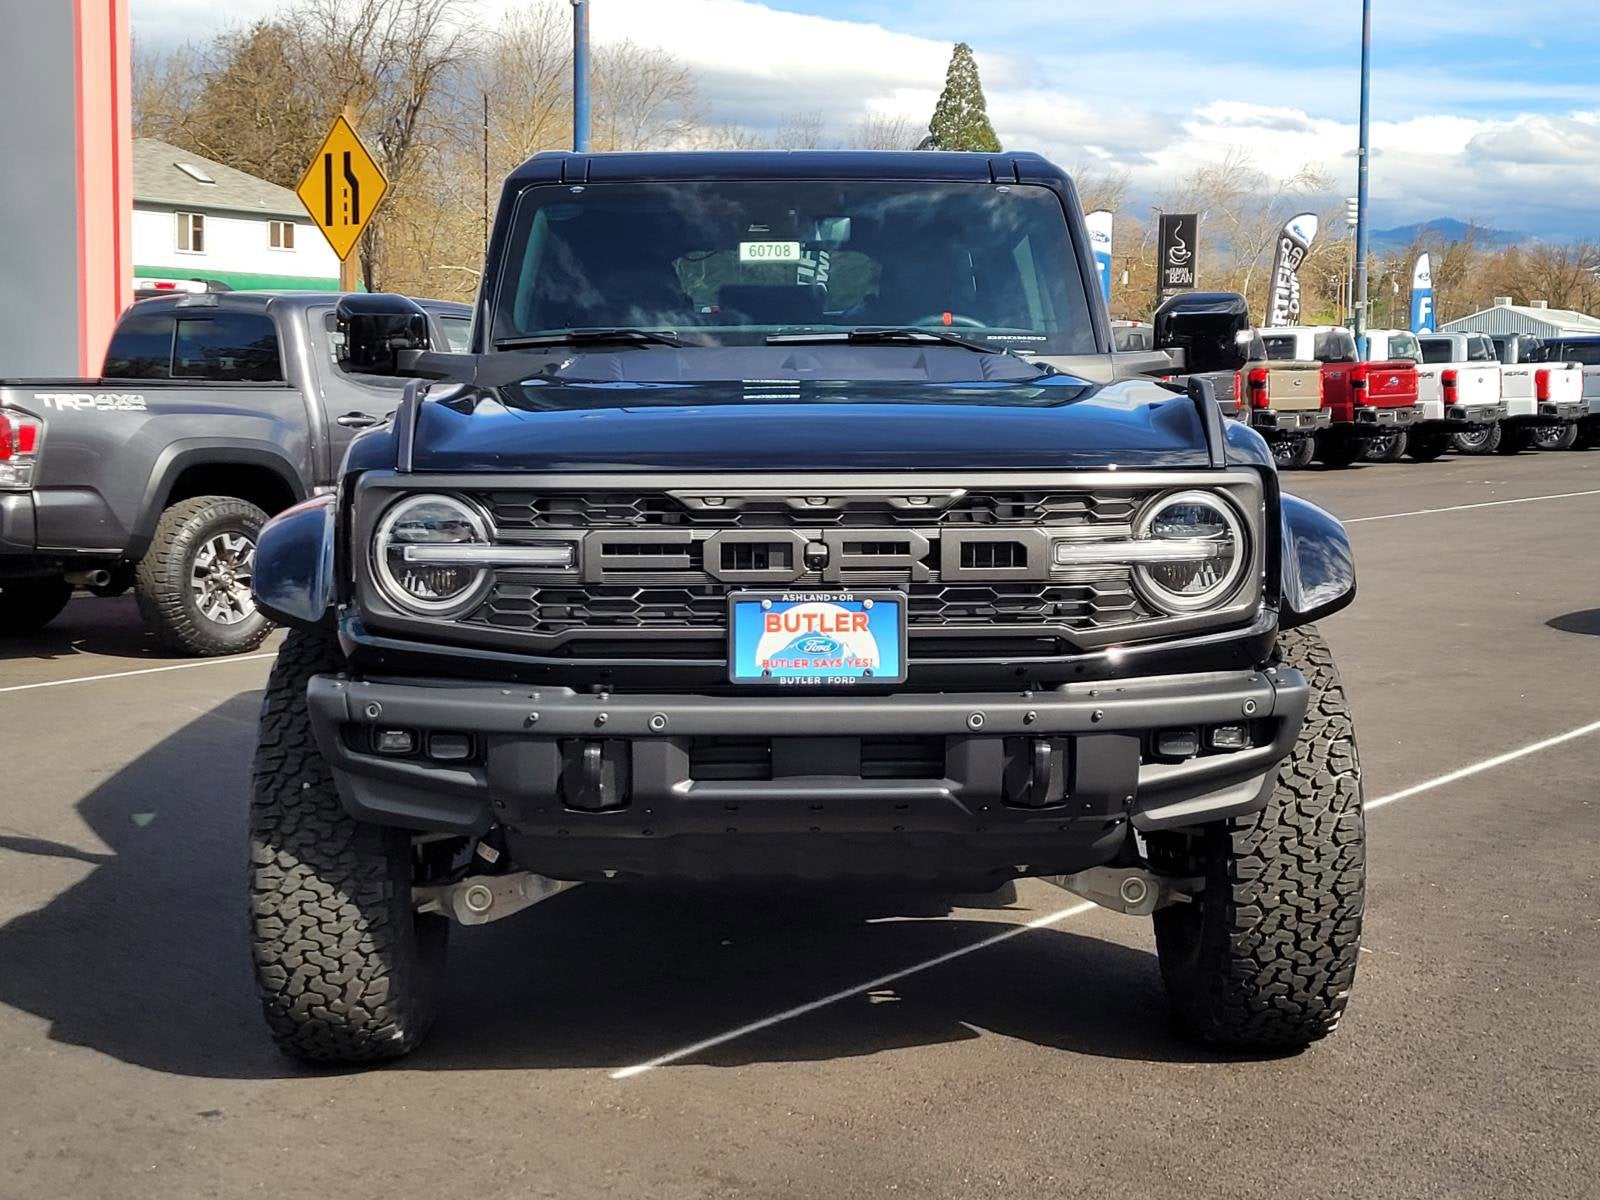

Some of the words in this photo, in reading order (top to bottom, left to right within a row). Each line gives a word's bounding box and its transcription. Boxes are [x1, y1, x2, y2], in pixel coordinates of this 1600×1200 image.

[748, 244, 791, 257] 60708
[1169, 273, 1193, 284] BEAN
[1271, 237, 1293, 328] RTIFIED
[34, 393, 95, 411] TRD
[583, 527, 1052, 584] FORD
[782, 594, 832, 602] ASHLAND
[839, 594, 854, 602] OR
[765, 612, 869, 633] BUTLER
[803, 638, 833, 653] Ford
[762, 658, 809, 669] BUTLER
[813, 658, 843, 668] SAYS
[843, 658, 874, 668] YES!
[779, 676, 821, 685] BUTLER
[828, 676, 856, 685] FORD
